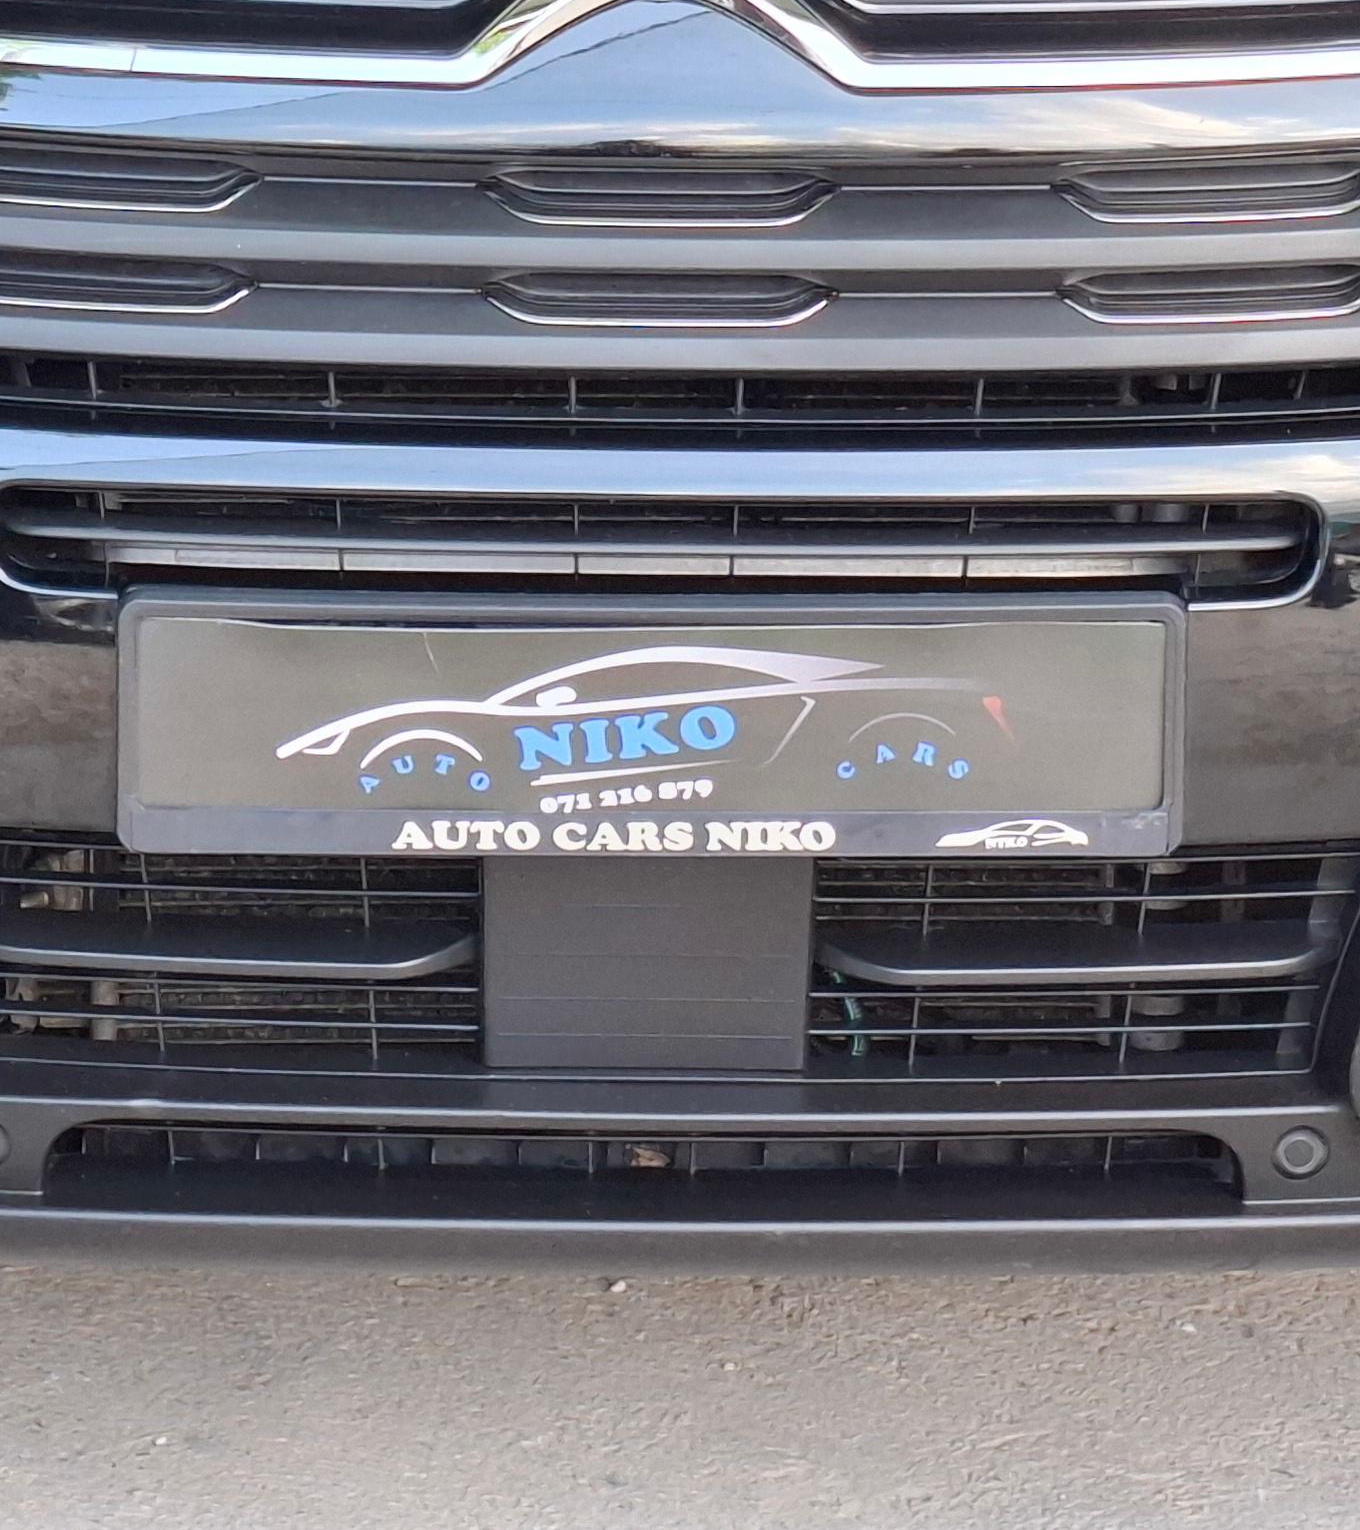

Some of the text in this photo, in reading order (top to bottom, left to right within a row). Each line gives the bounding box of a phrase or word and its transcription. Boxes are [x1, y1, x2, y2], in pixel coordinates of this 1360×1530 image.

[514, 705, 736, 770] NIKO
[539, 792, 592, 814] 071
[599, 784, 653, 807] 216
[391, 820, 837, 852] AUTO CARS NIKO
